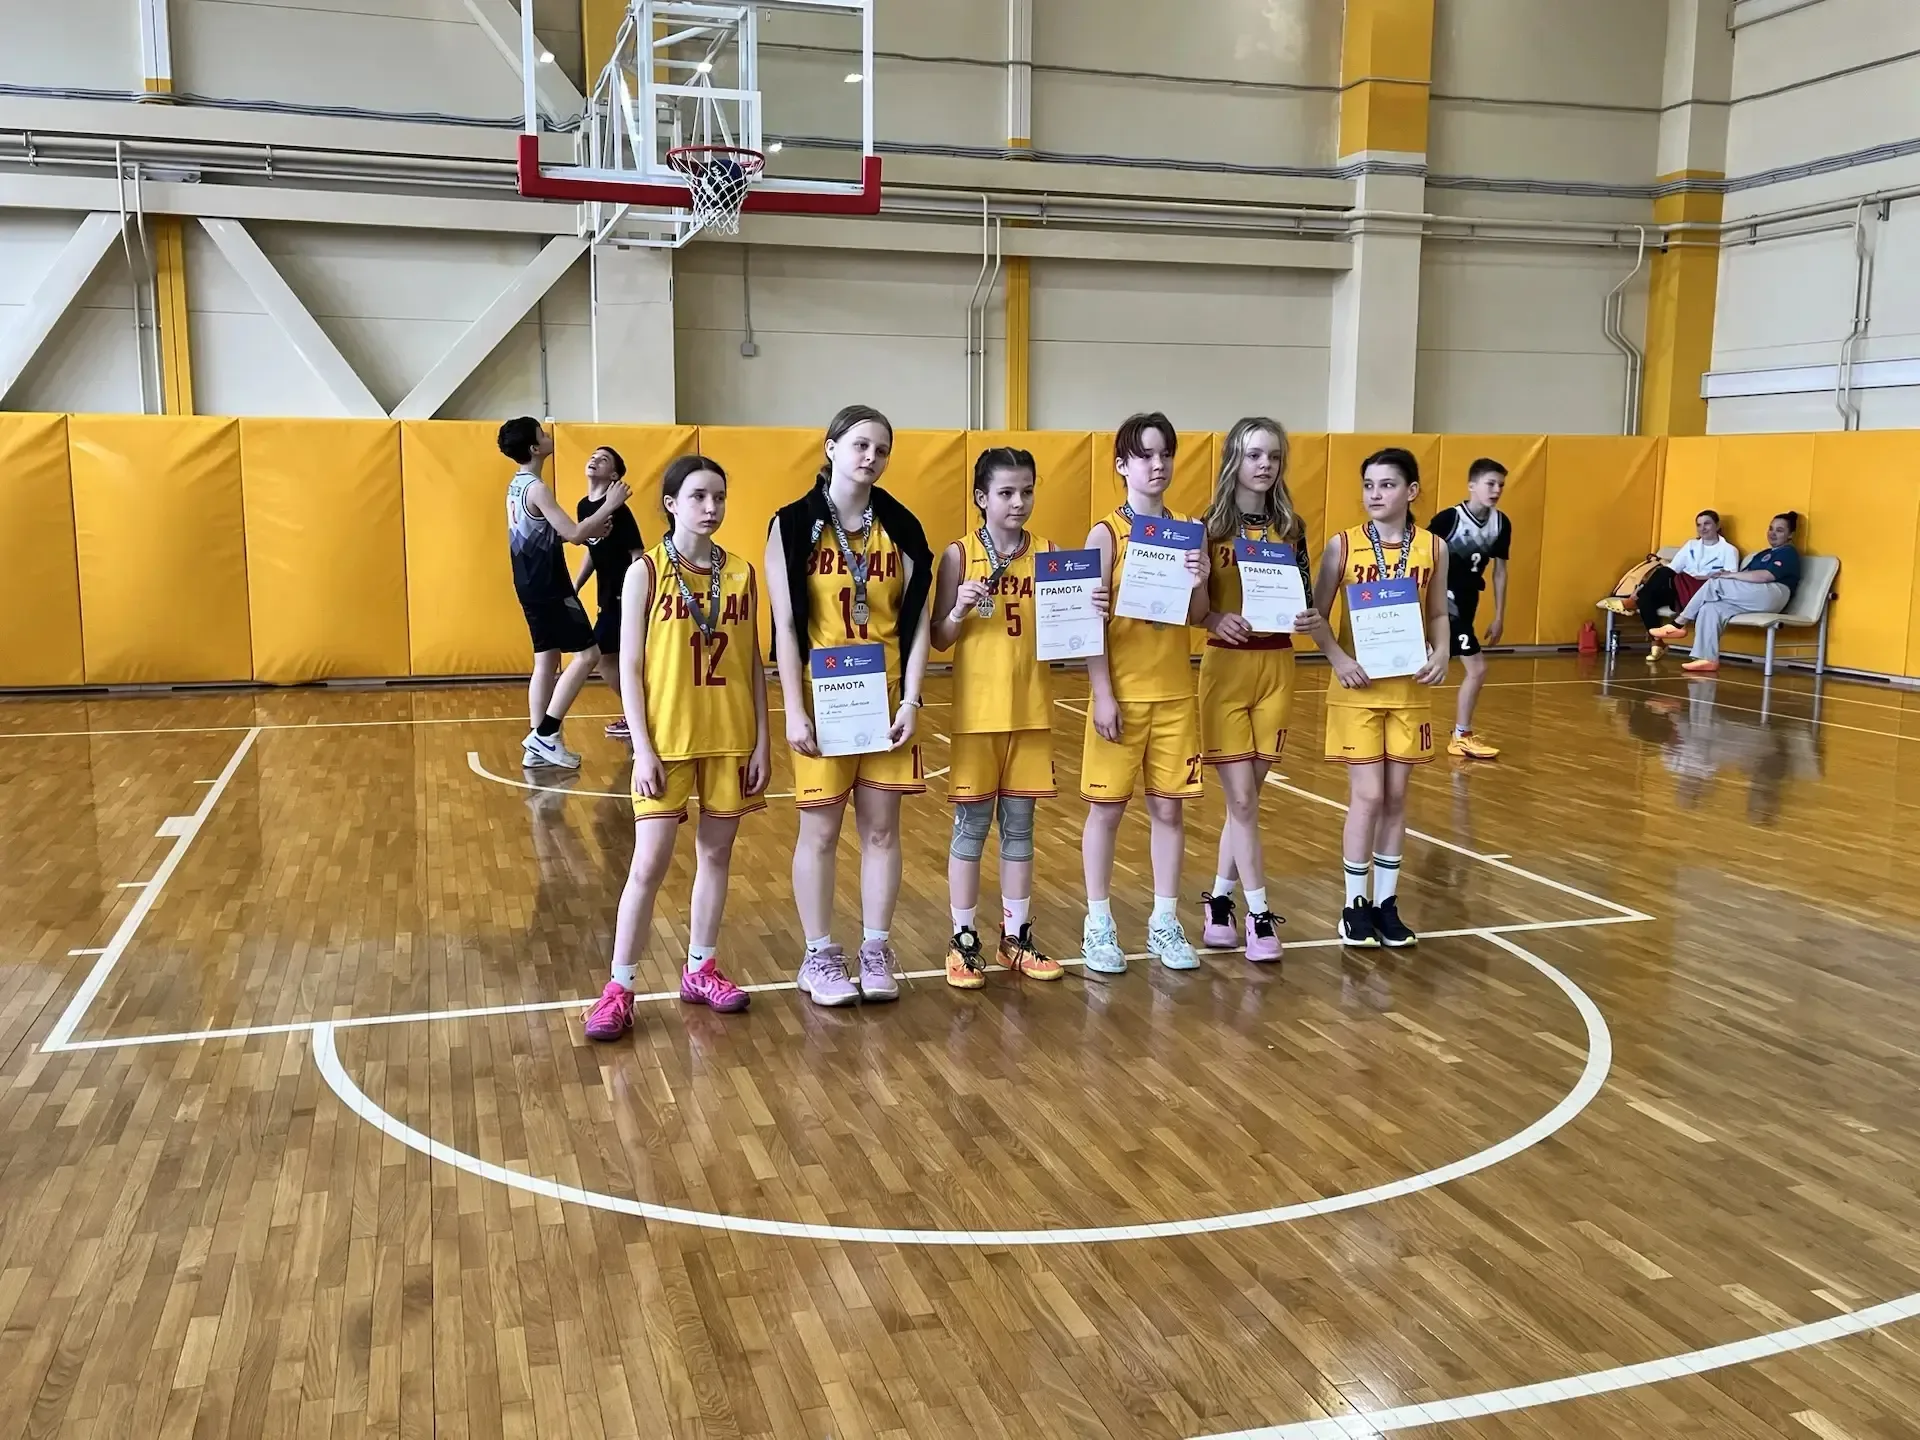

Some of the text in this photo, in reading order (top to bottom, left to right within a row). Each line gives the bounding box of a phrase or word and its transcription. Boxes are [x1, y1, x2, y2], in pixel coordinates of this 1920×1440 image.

[806, 548, 897, 582] ЗВЕДА
[1131, 548, 1176, 562] ГРАМОТА
[1243, 566, 1283, 576] ГРАМОТА
[1354, 564, 1430, 590] ЗВЕДА
[1040, 585, 1083, 597] ГРАМОТА
[660, 593, 749, 625] ЗВЕДА
[1005, 603, 1022, 637] 5
[1458, 634, 1471, 650] 2
[690, 631, 729, 687] 12
[818, 680, 865, 693] ГРАМОТА
[1419, 723, 1432, 751] 18
